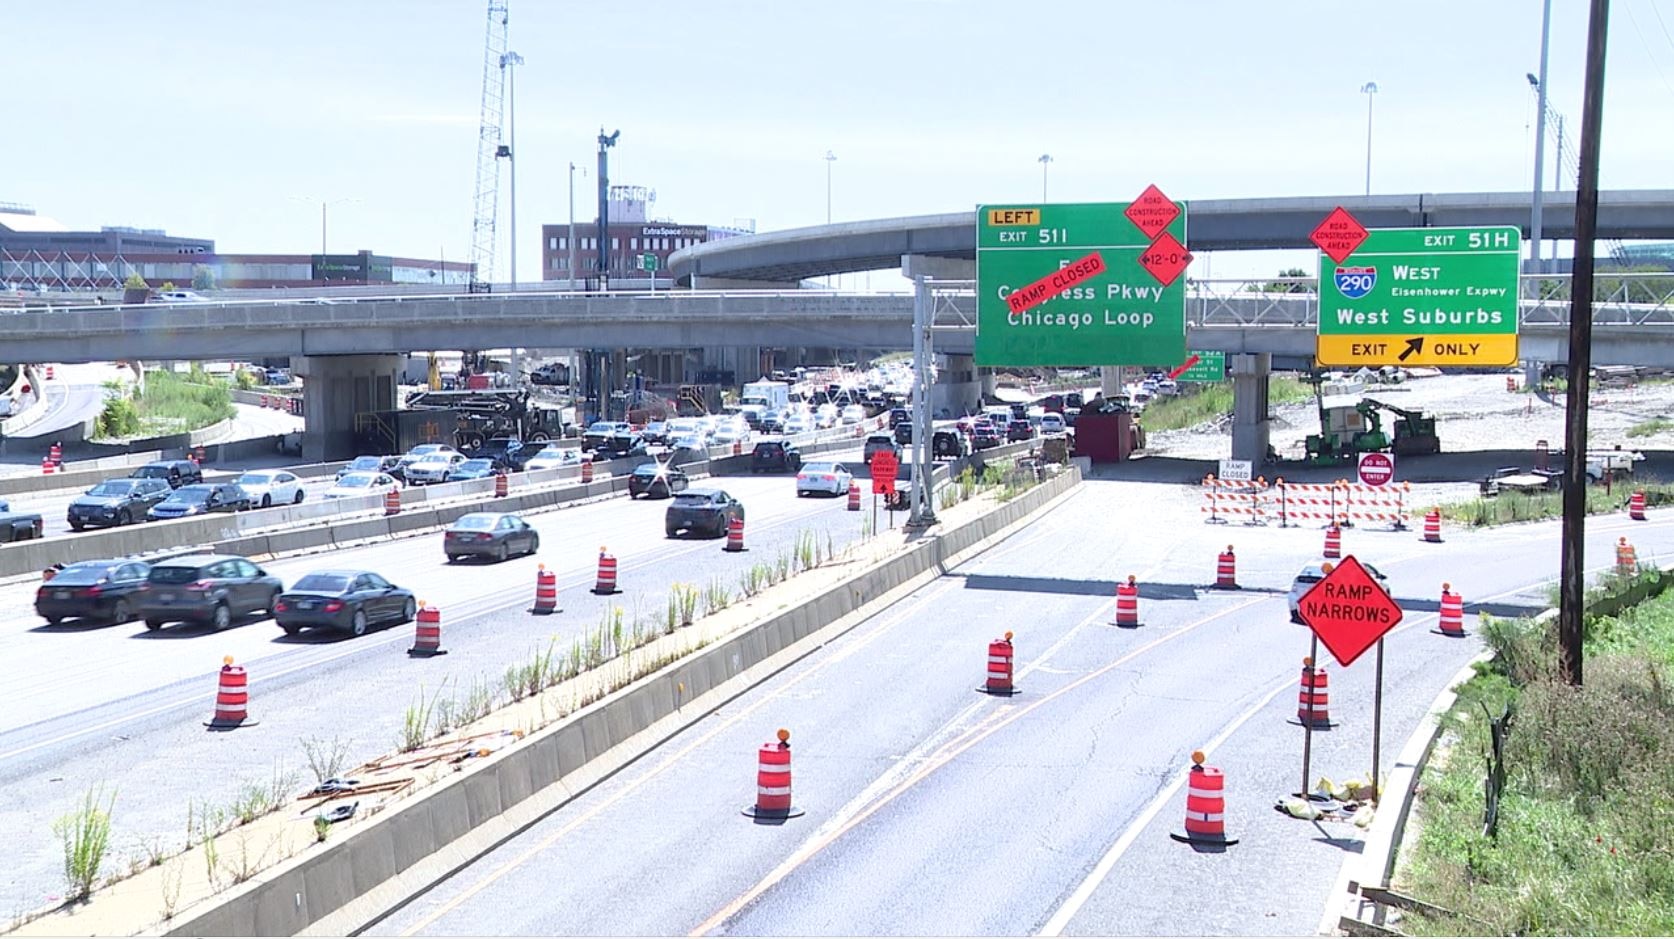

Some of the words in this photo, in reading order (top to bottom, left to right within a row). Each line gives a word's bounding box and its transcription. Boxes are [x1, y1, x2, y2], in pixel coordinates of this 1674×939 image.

[994, 211, 1033, 224] LEFT
[1128, 208, 1177, 216] CONSTRUCTION
[1142, 219, 1164, 227] AHEAD
[1000, 231, 1027, 242] EXIT
[1315, 232, 1363, 240] CONSTRUCTION
[1424, 235, 1455, 247] EXIT
[1469, 232, 1508, 248] 51H
[1326, 242, 1351, 250] AHEAD
[1392, 265, 1440, 280] WEST
[1011, 284, 1047, 310] RAMP
[1052, 258, 1100, 289] CLOSED
[1341, 275, 1372, 291] 290
[1107, 284, 1163, 303] Pkwy
[1391, 287, 1460, 297] Eisenhower
[1466, 286, 1507, 298] Expwy
[1008, 310, 1093, 330] Chicago
[1105, 309, 1153, 328] Loop
[1337, 308, 1390, 325] West
[1403, 307, 1502, 325] Suburbs
[1352, 343, 1387, 356] EXIT
[1434, 343, 1480, 356] ONLY
[1226, 462, 1246, 470] RAMP
[1221, 471, 1250, 479] CLOSED
[1325, 583, 1373, 600] RAMP
[1307, 602, 1390, 624] NARROWS
